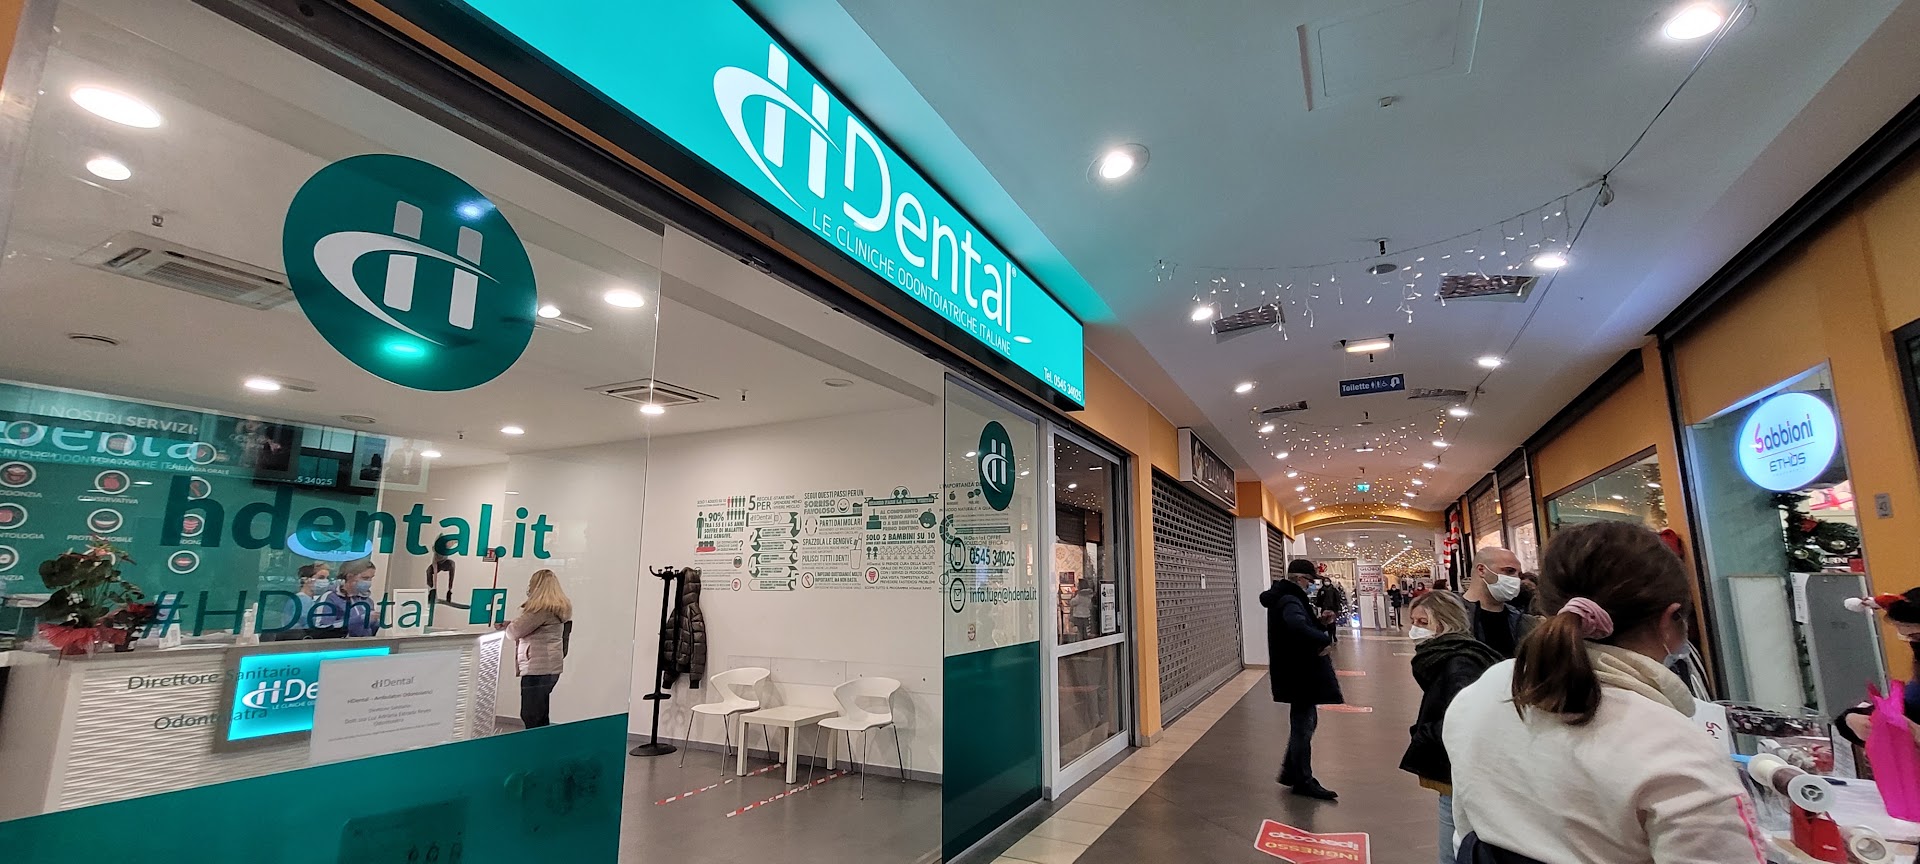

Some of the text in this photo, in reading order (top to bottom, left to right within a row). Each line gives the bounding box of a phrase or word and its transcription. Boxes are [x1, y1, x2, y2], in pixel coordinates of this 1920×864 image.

[713, 43, 1016, 334] HDental
[812, 207, 1011, 356] LE CLINICHE ODONTOIATRICHE ITALIANE
[1043, 366, 1082, 402] Tel. 0545 34025
[1342, 382, 1370, 392] Toilette
[46, 406, 123, 425] NOSTRI
[126, 415, 198, 435] SERVIZI:
[1754, 413, 1814, 454] Sabbioni
[1769, 452, 1806, 472] ETHOS
[748, 495, 756, 511] 5
[818, 490, 834, 499] QUESTI
[757, 501, 772, 511] PER
[804, 499, 836, 508] SORRISO
[804, 507, 836, 515] FAVOLOSO
[160, 474, 553, 561] hdental.it
[708, 511, 724, 522] 90%
[820, 519, 834, 527] PARTI
[843, 518, 863, 526] MOLARI
[803, 537, 853, 546] SPAZZOLA LE GENGIVE
[866, 533, 880, 541] SOLO
[882, 533, 887, 541] 2
[888, 532, 915, 540] BAMBINI
[917, 532, 925, 540] SU
[820, 554, 833, 562] TUTTI
[835, 554, 849, 562] DENTI
[970, 547, 1015, 567] 0545 34025
[141, 588, 436, 638] #HDental
[127, 664, 301, 690] Direttore Sanitario
[1265, 842, 1359, 861] INGRESSO
